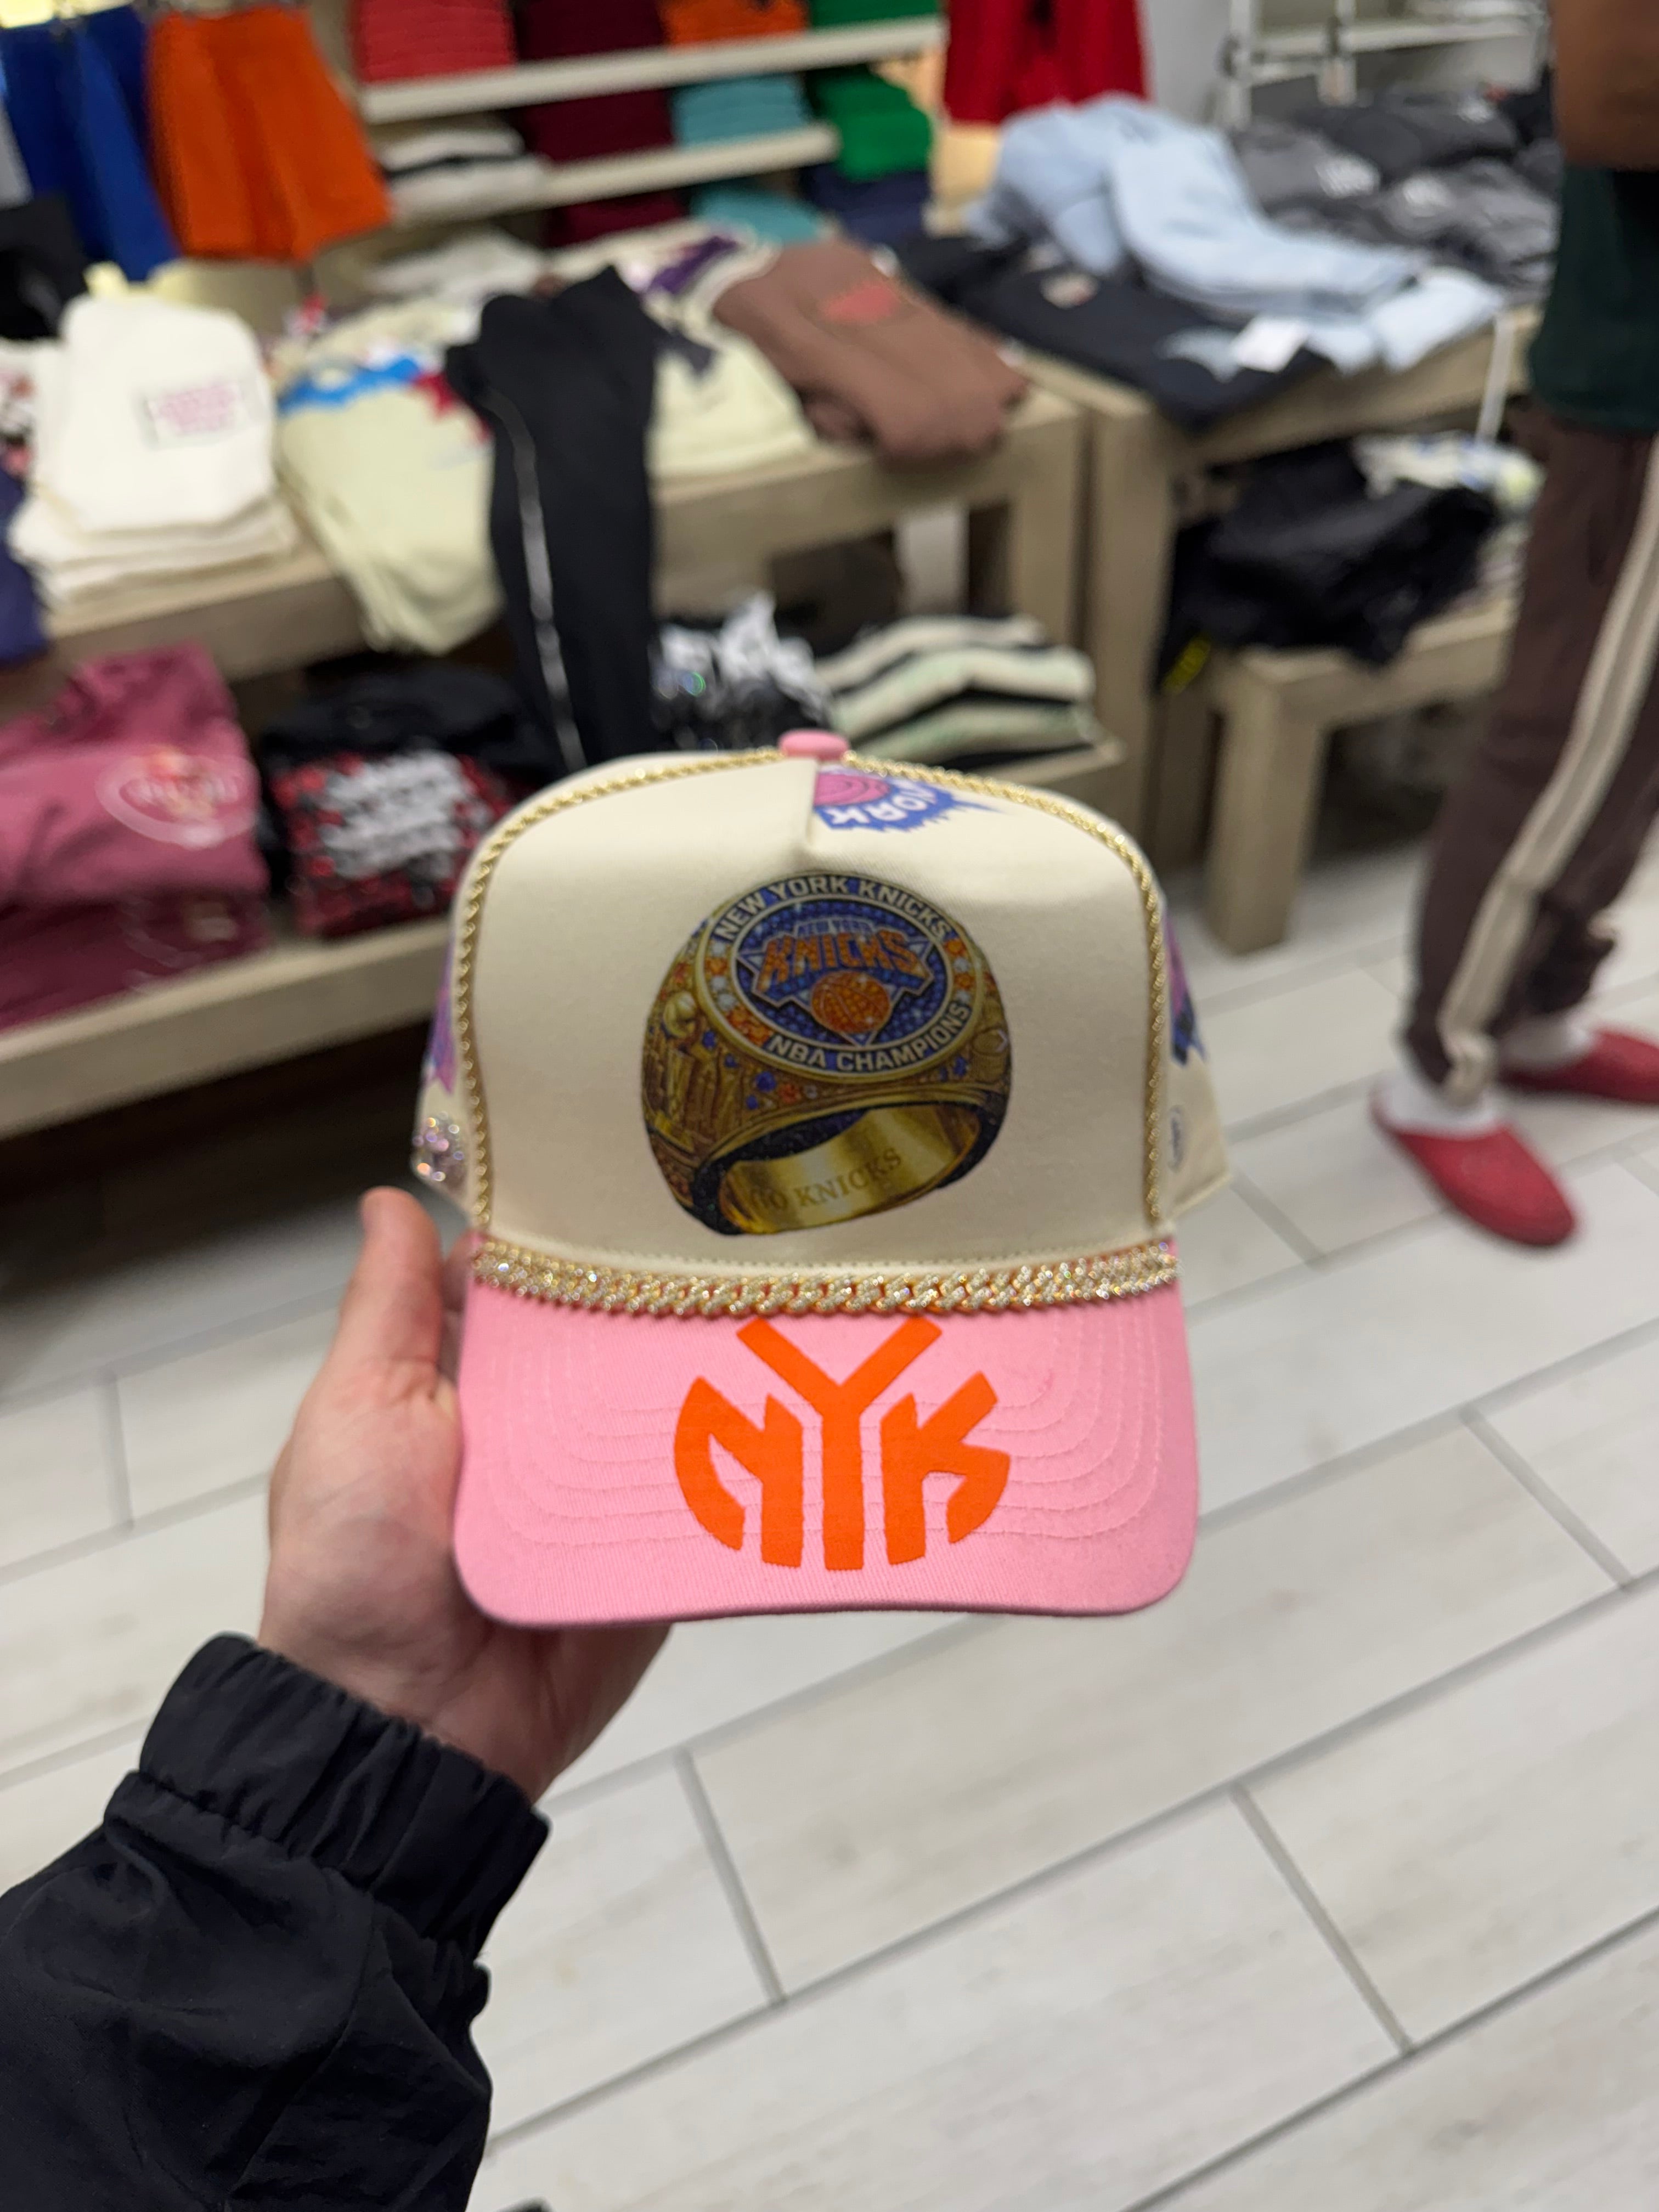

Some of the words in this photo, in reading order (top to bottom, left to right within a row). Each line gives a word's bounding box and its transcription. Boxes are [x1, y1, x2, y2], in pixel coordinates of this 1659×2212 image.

[714, 891, 767, 943] NEW
[769, 876, 849, 901] YORK
[859, 879, 952, 941] KNICKS
[755, 929, 928, 994] KNICKS
[769, 1032, 826, 1069] NBA
[836, 1001, 971, 1072] CHAMPIONS
[793, 1147, 901, 1207] KNICKS
